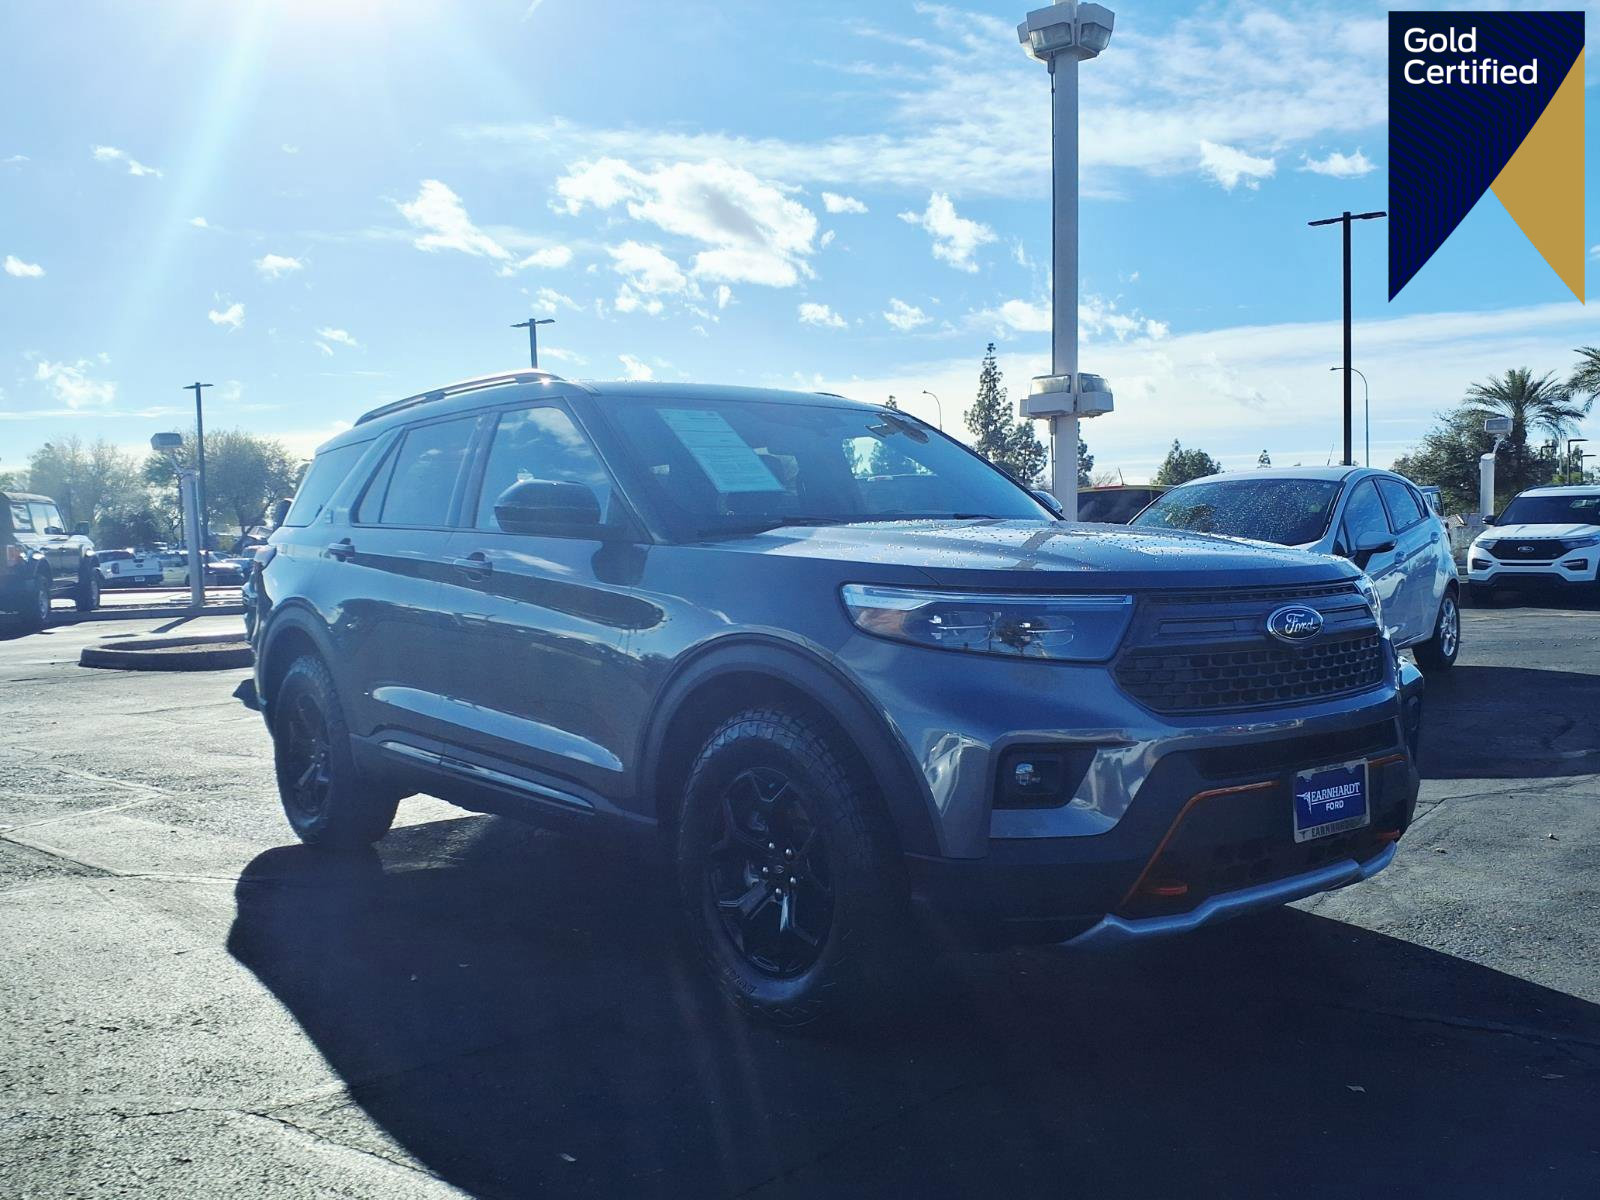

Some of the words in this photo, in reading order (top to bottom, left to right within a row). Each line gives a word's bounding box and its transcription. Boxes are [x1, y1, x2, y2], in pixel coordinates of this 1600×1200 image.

[1284, 613, 1319, 634] Ford
[1311, 782, 1361, 802] EARNHARDT
[1325, 800, 1345, 811] FORD
